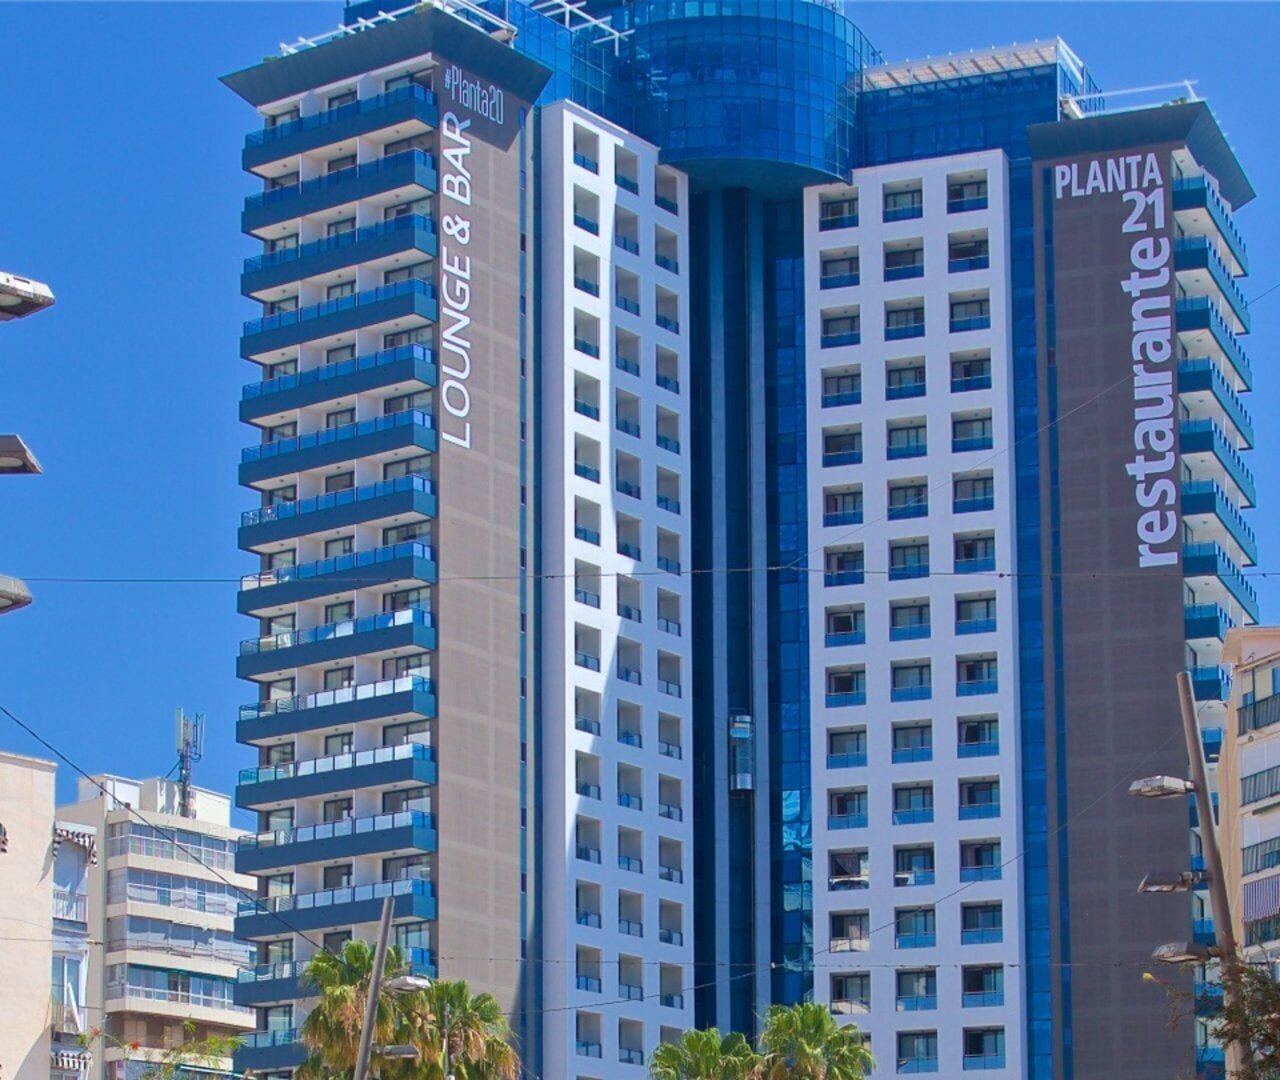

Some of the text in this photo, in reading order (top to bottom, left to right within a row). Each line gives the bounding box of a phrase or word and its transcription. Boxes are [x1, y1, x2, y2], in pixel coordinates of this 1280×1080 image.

[443, 64, 504, 124] #Planta20
[1054, 152, 1163, 199] PLANTA
[1122, 187, 1165, 234] 21
[442, 110, 471, 449] LOUNGE & BAR
[1121, 236, 1178, 568] restaurante
